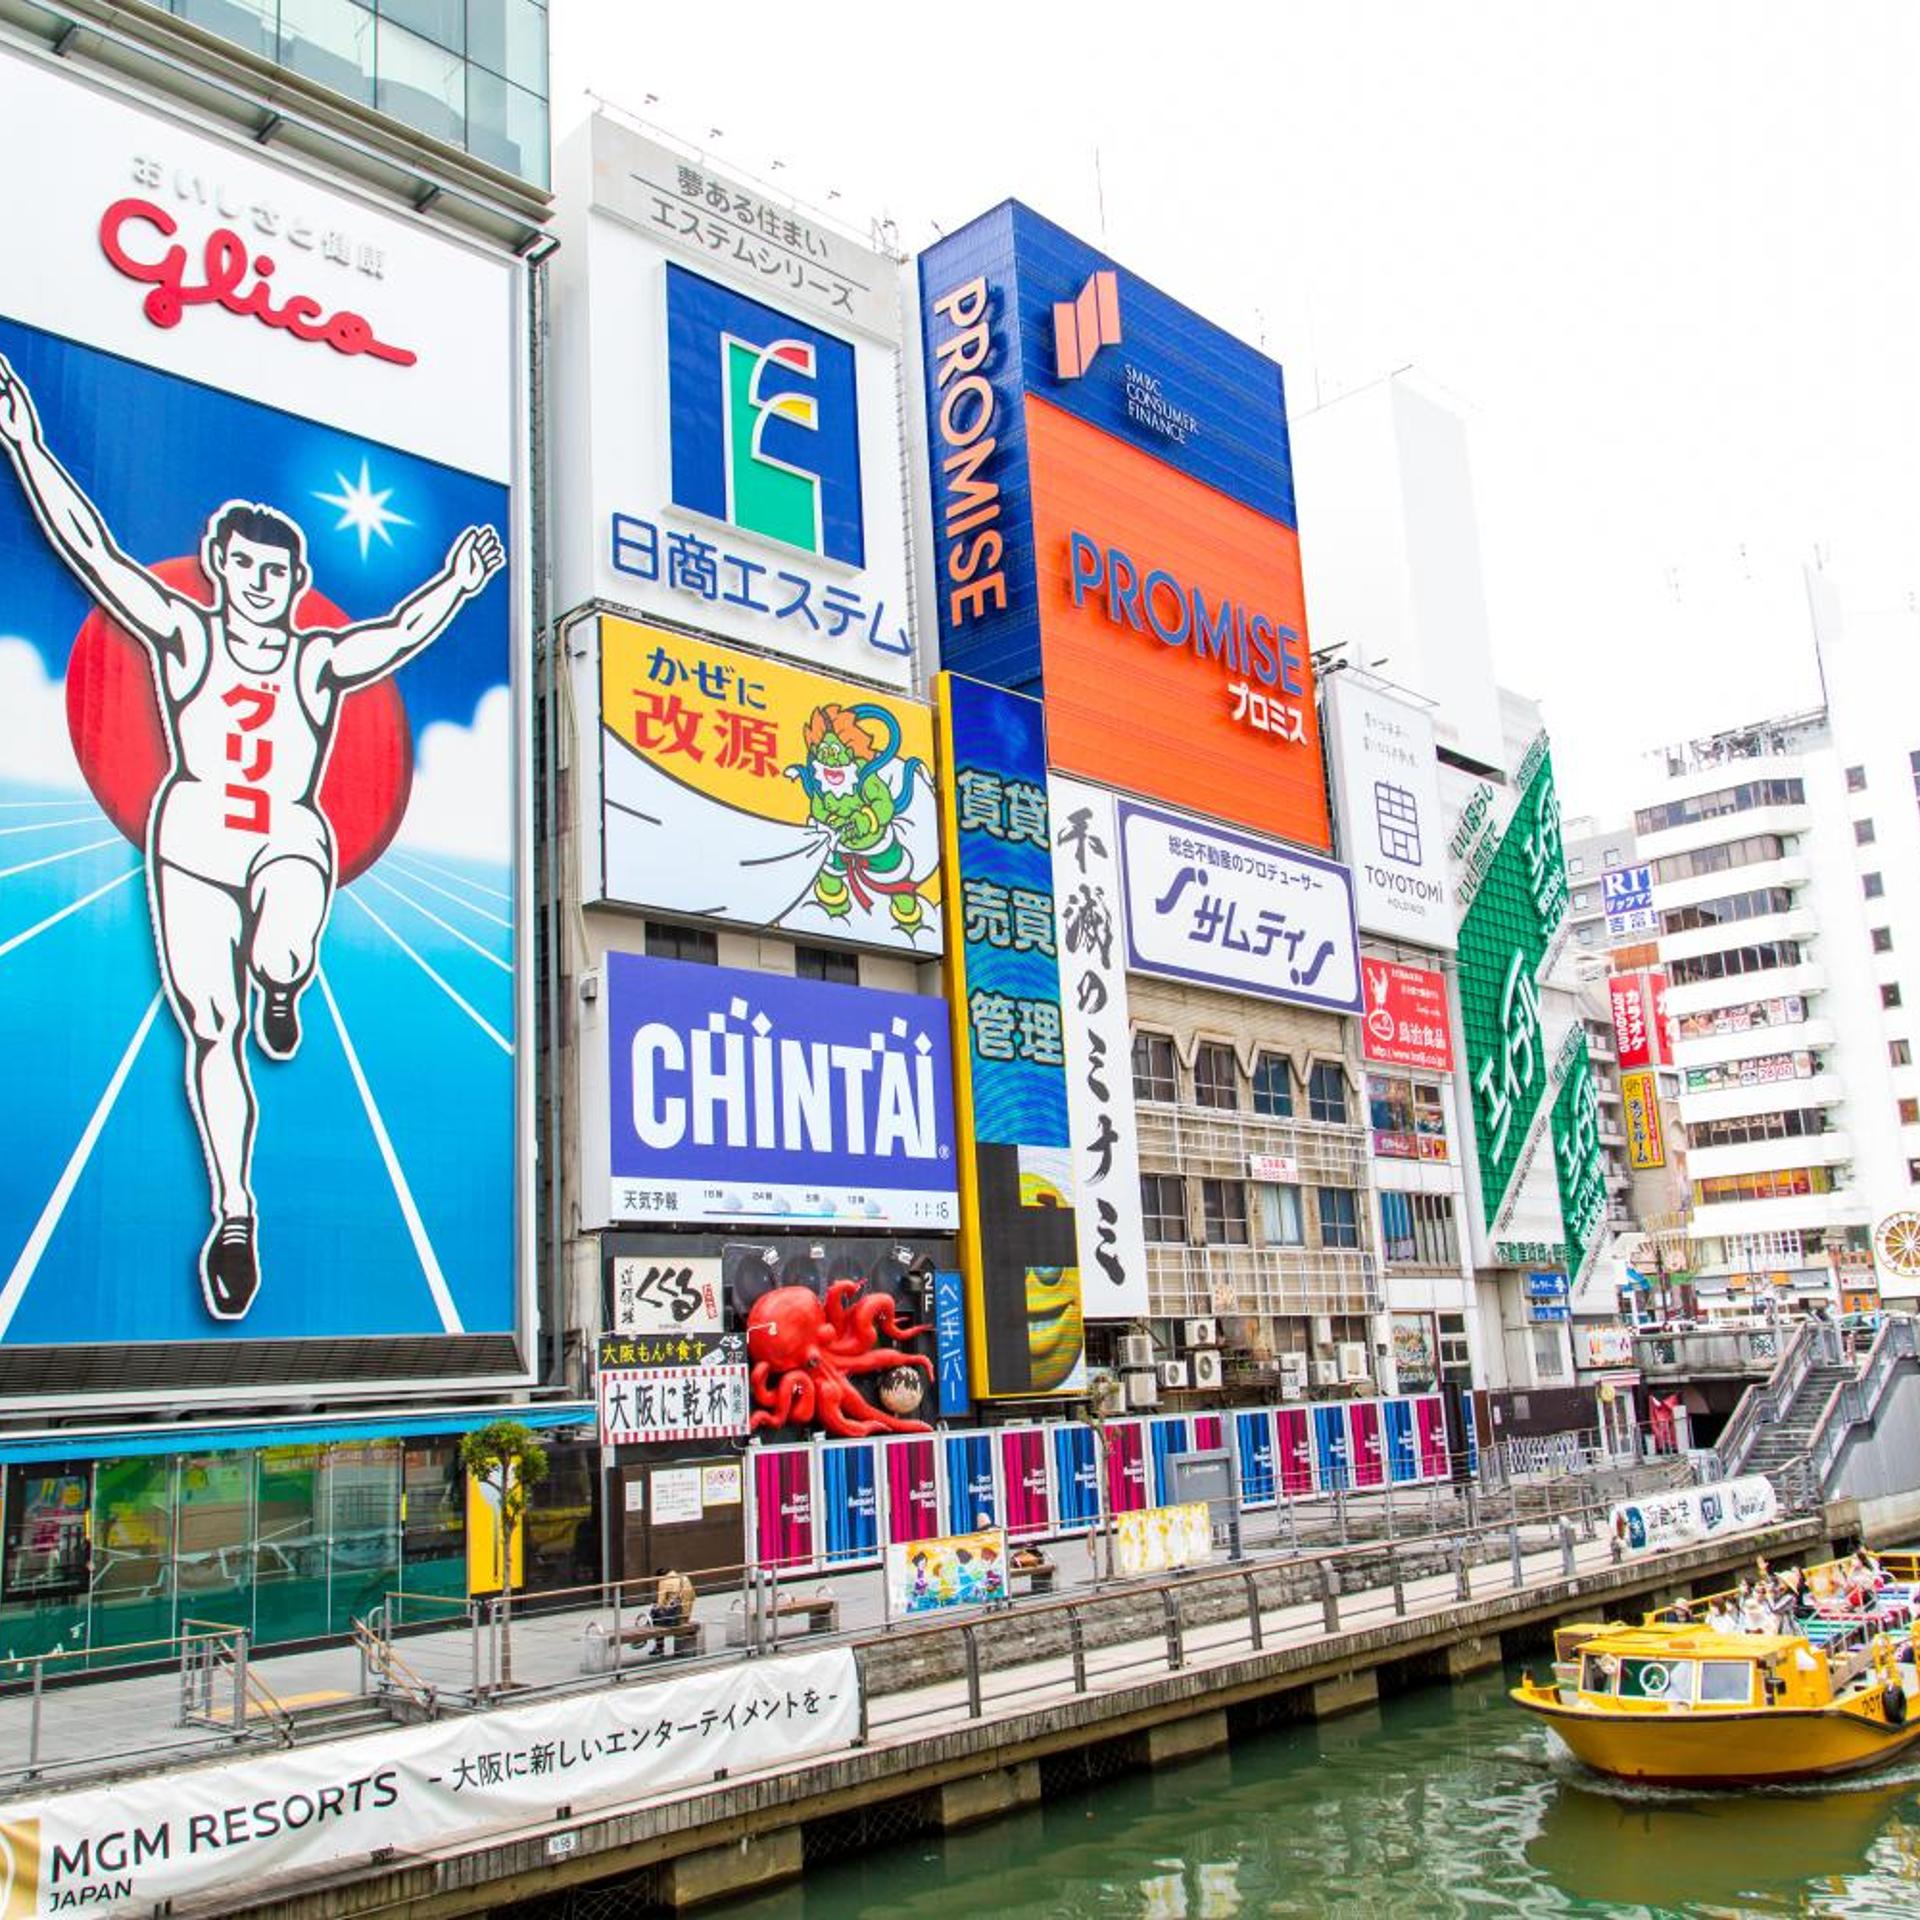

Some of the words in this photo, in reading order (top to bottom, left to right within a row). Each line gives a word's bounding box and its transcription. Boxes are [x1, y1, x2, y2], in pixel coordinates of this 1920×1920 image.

[677, 165, 828, 258] 夢ある住まい
[651, 196, 854, 313] エステムシリーズ
[1125, 364, 1162, 397] SMBC
[1126, 382, 1198, 436] CONSUMER
[933, 276, 1007, 627] PROMISE
[1128, 399, 1187, 444] FINANCE
[611, 512, 915, 657] 日商エステム
[1069, 529, 1303, 695] PROMISE
[646, 646, 767, 711] かぜに
[1227, 682, 1308, 746] プロミス
[221, 681, 281, 835] グリコ
[632, 688, 780, 779] 改源
[957, 767, 1049, 848] 賃貸
[963, 878, 1057, 957] 売買
[1364, 864, 1444, 903] TOYOTOMI
[968, 987, 1065, 1066] 管理
[1626, 989, 1646, 1051] カラオケ
[623, 1190, 679, 1211] 天気予報
[635, 1266, 703, 1323] くくる
[940, 1283, 963, 1402] ペンギンバー
[609, 1378, 729, 1431] 大阪に乾杯
[51, 1822, 170, 1884] MGM
[189, 1771, 399, 1854] RESORTS
[49, 1878, 133, 1913] JAPAN
